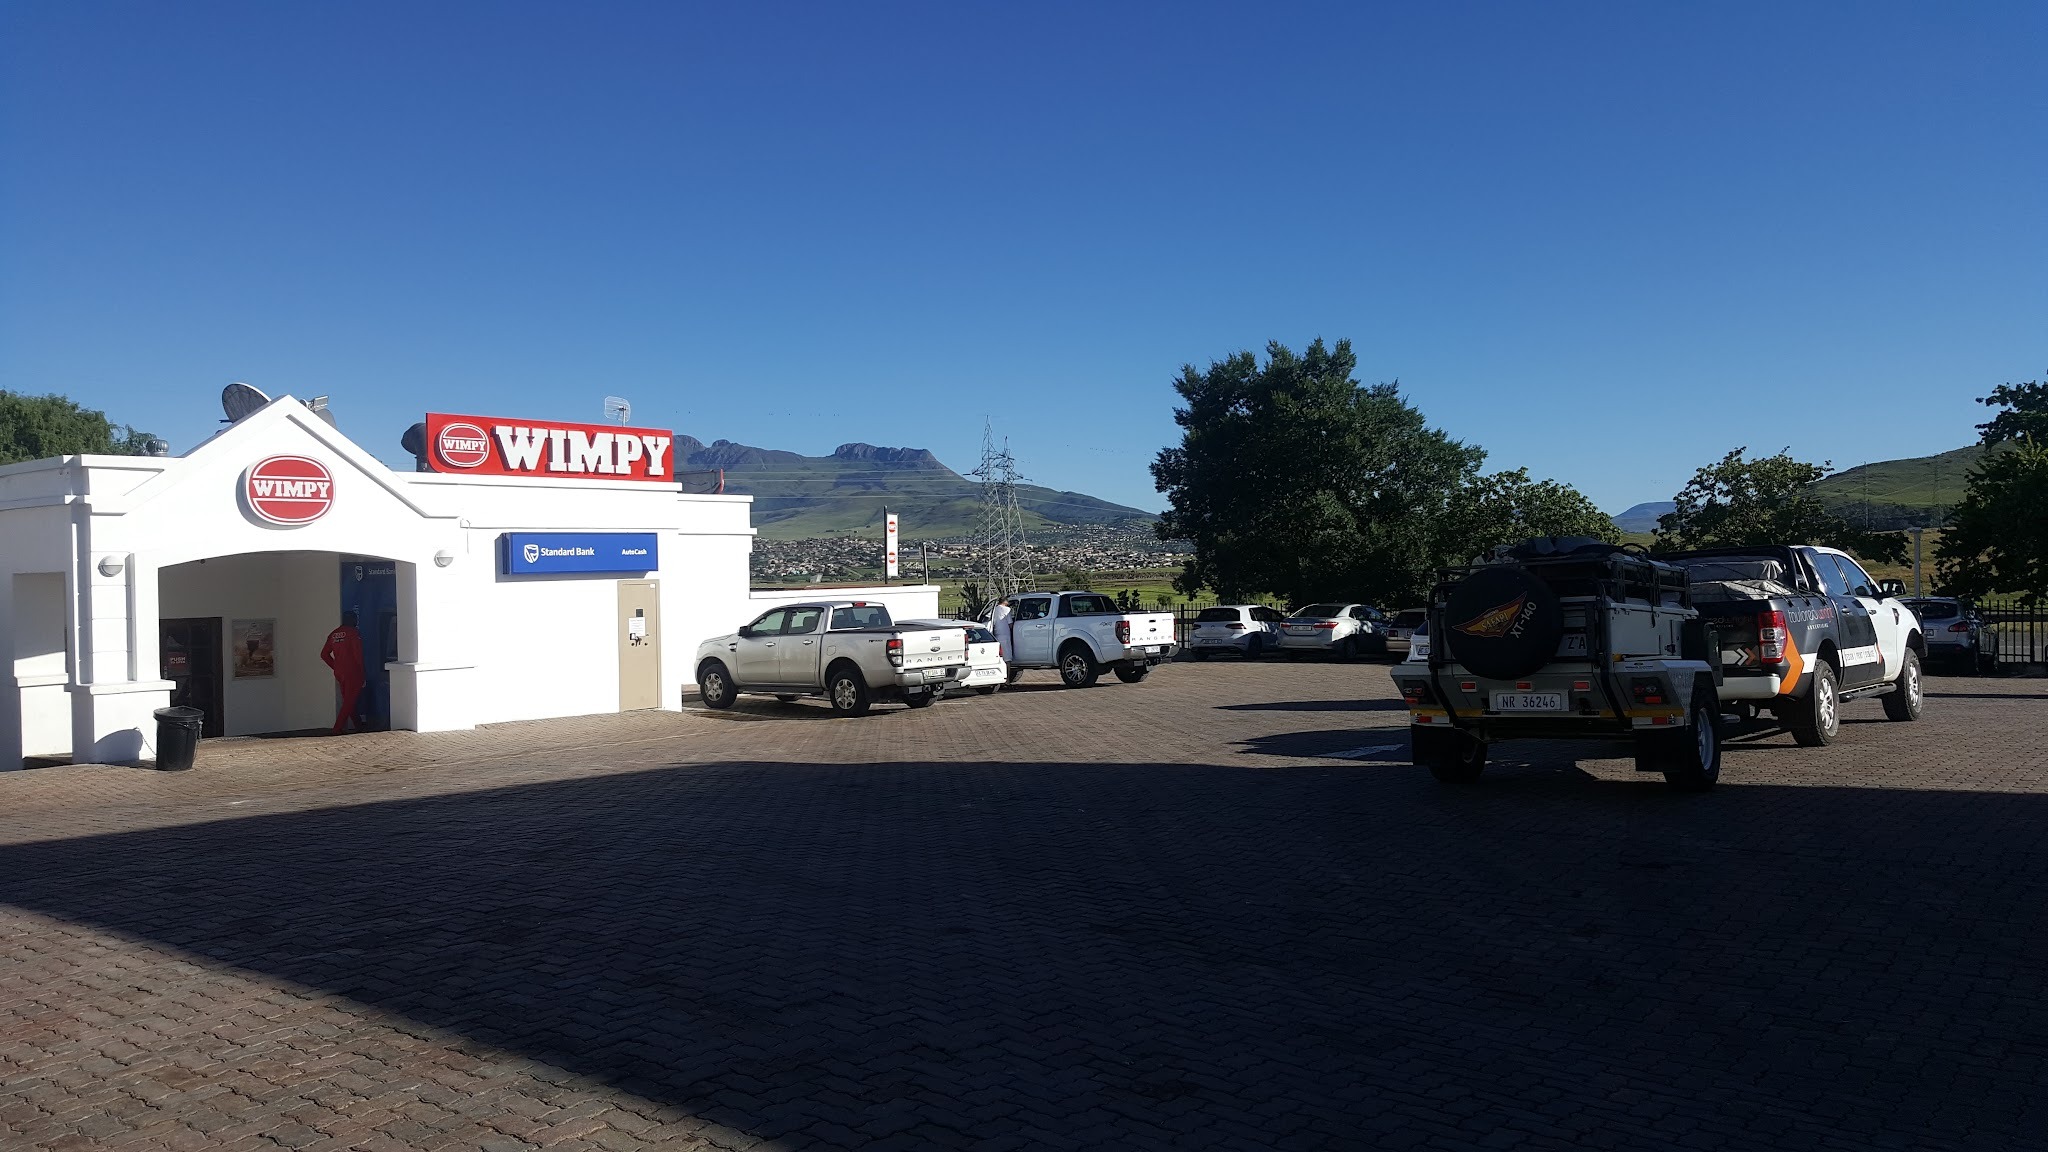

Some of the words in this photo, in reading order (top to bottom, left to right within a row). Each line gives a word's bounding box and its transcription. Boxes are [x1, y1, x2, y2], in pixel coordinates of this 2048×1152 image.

[442, 438, 487, 451] WIMPY
[495, 425, 670, 475] WIMPY
[252, 480, 331, 498] WIMPY
[541, 547, 575, 557] Standard
[576, 547, 595, 556] Bank
[1481, 612, 1509, 631] SAFARI
[1510, 601, 1537, 639] XT-140
[906, 654, 963, 664] RANGER
[1502, 696, 1516, 708] NR
[1522, 696, 1556, 708] 36246
